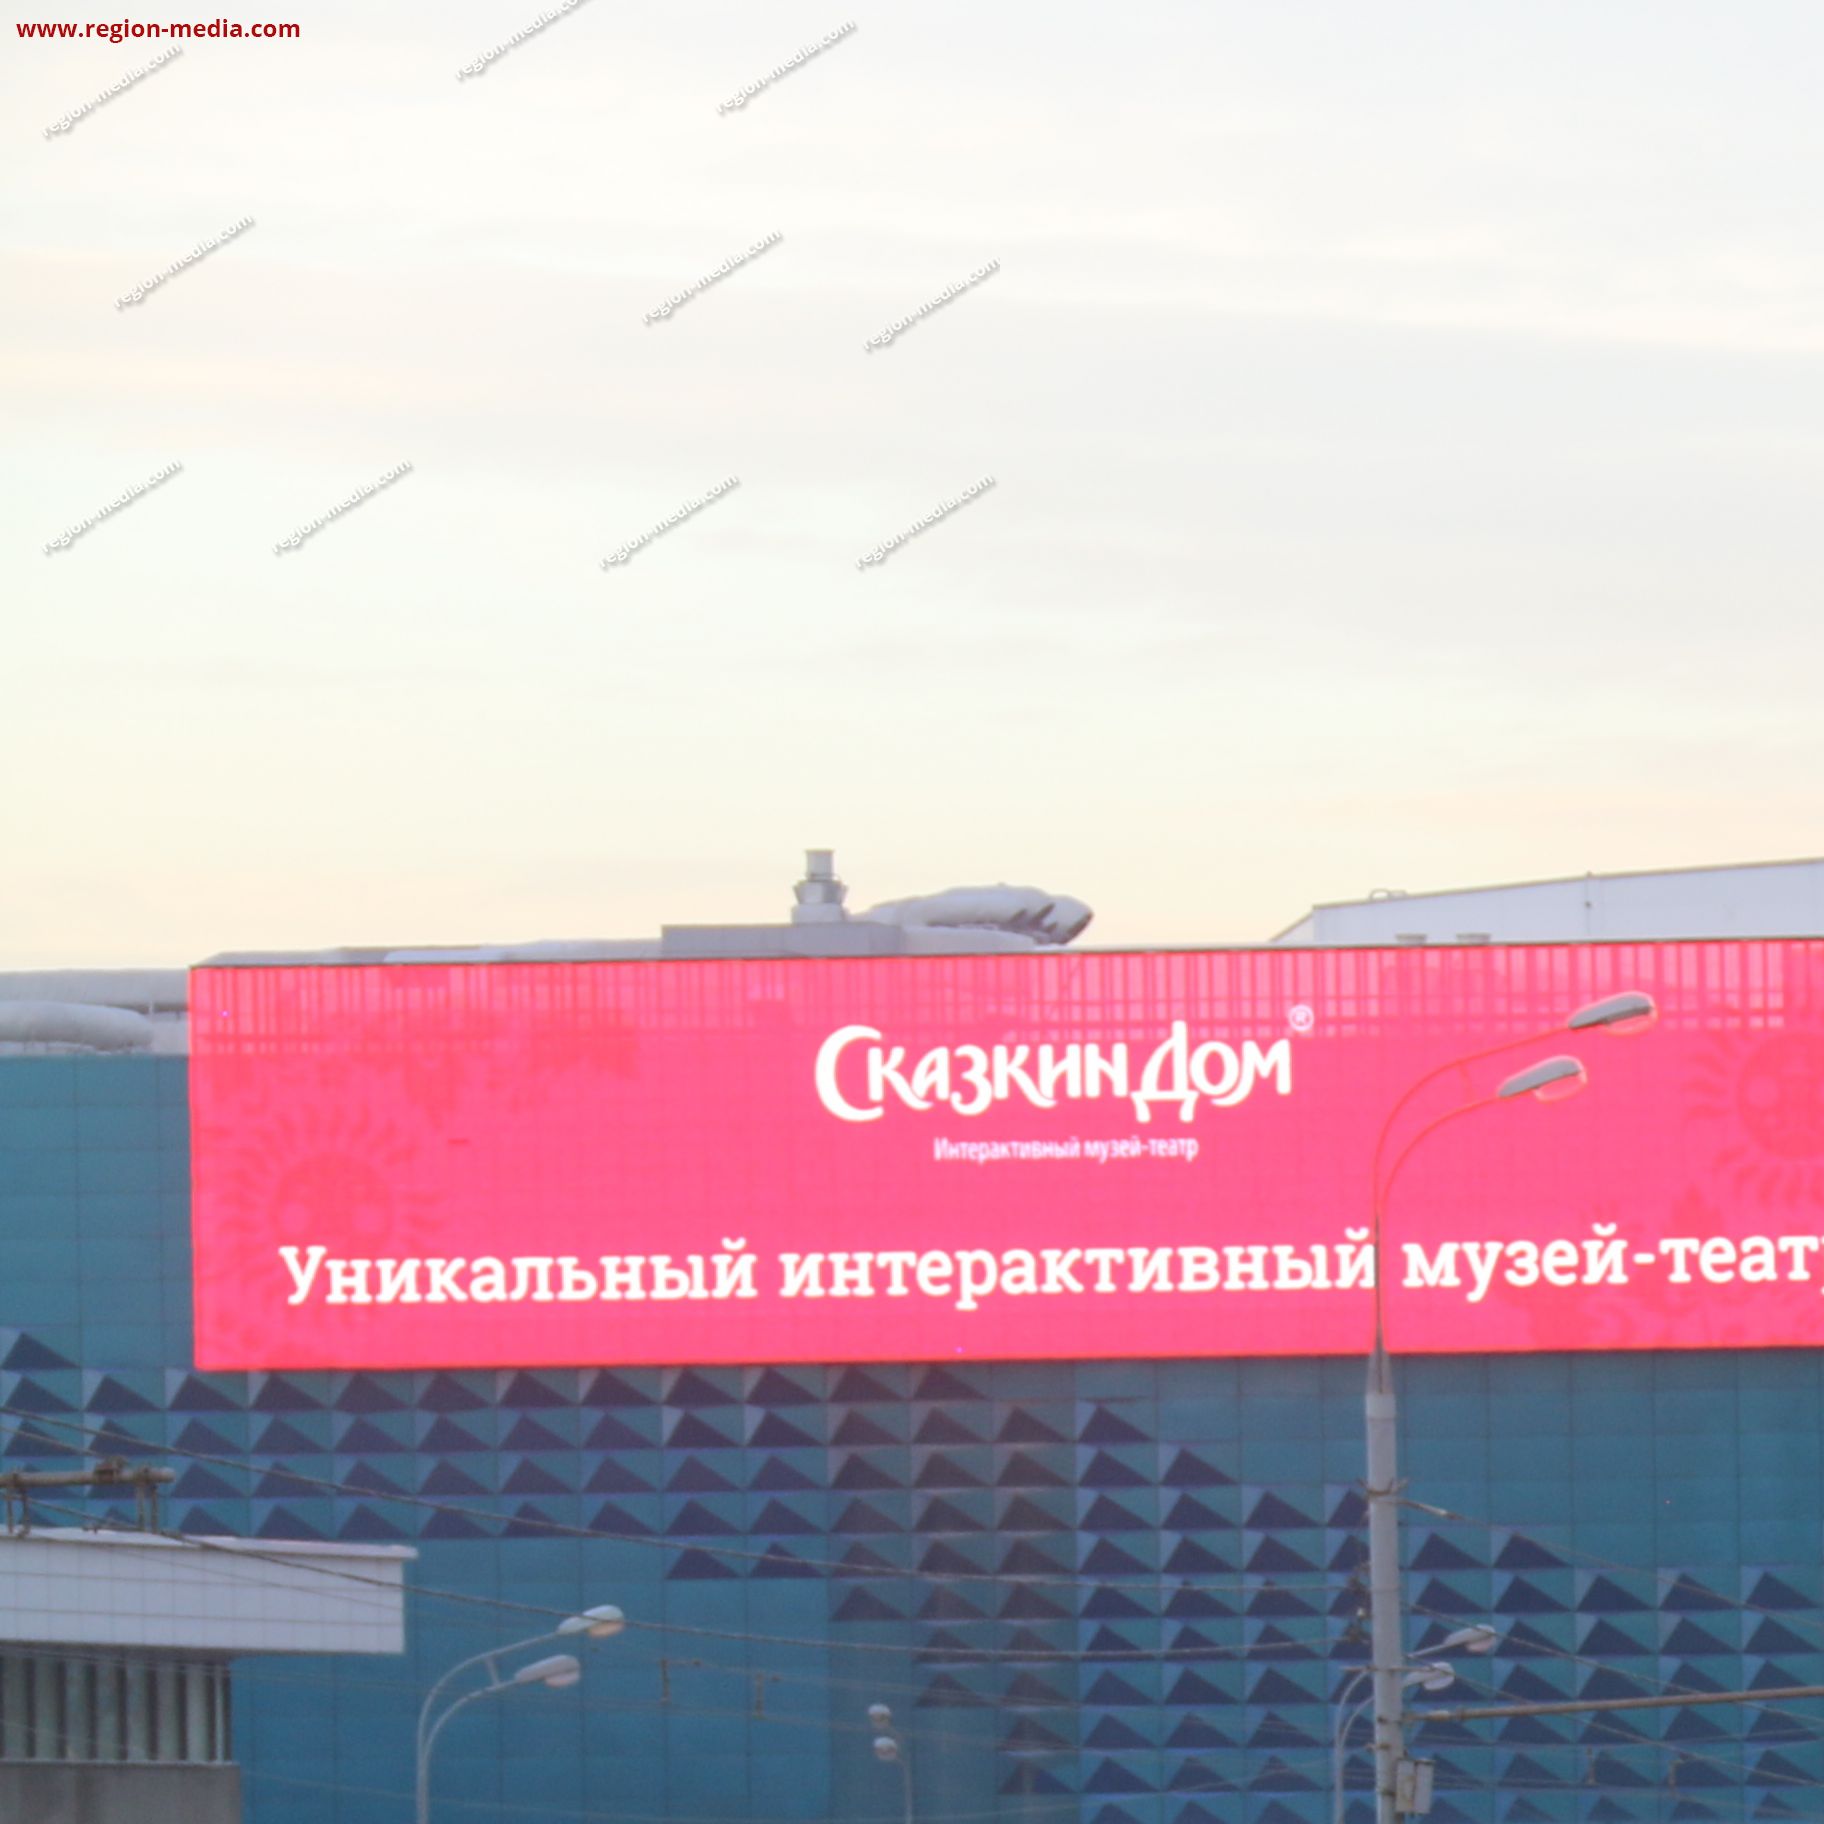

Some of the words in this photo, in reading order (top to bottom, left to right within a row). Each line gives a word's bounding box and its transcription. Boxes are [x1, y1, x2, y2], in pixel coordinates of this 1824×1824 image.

[934, 1137, 1081, 1163] Интерактивный
[1084, 1134, 1199, 1164] музей-театр
[279, 1236, 759, 1306] Уникальный
[778, 1227, 1376, 1311] интерактивный
